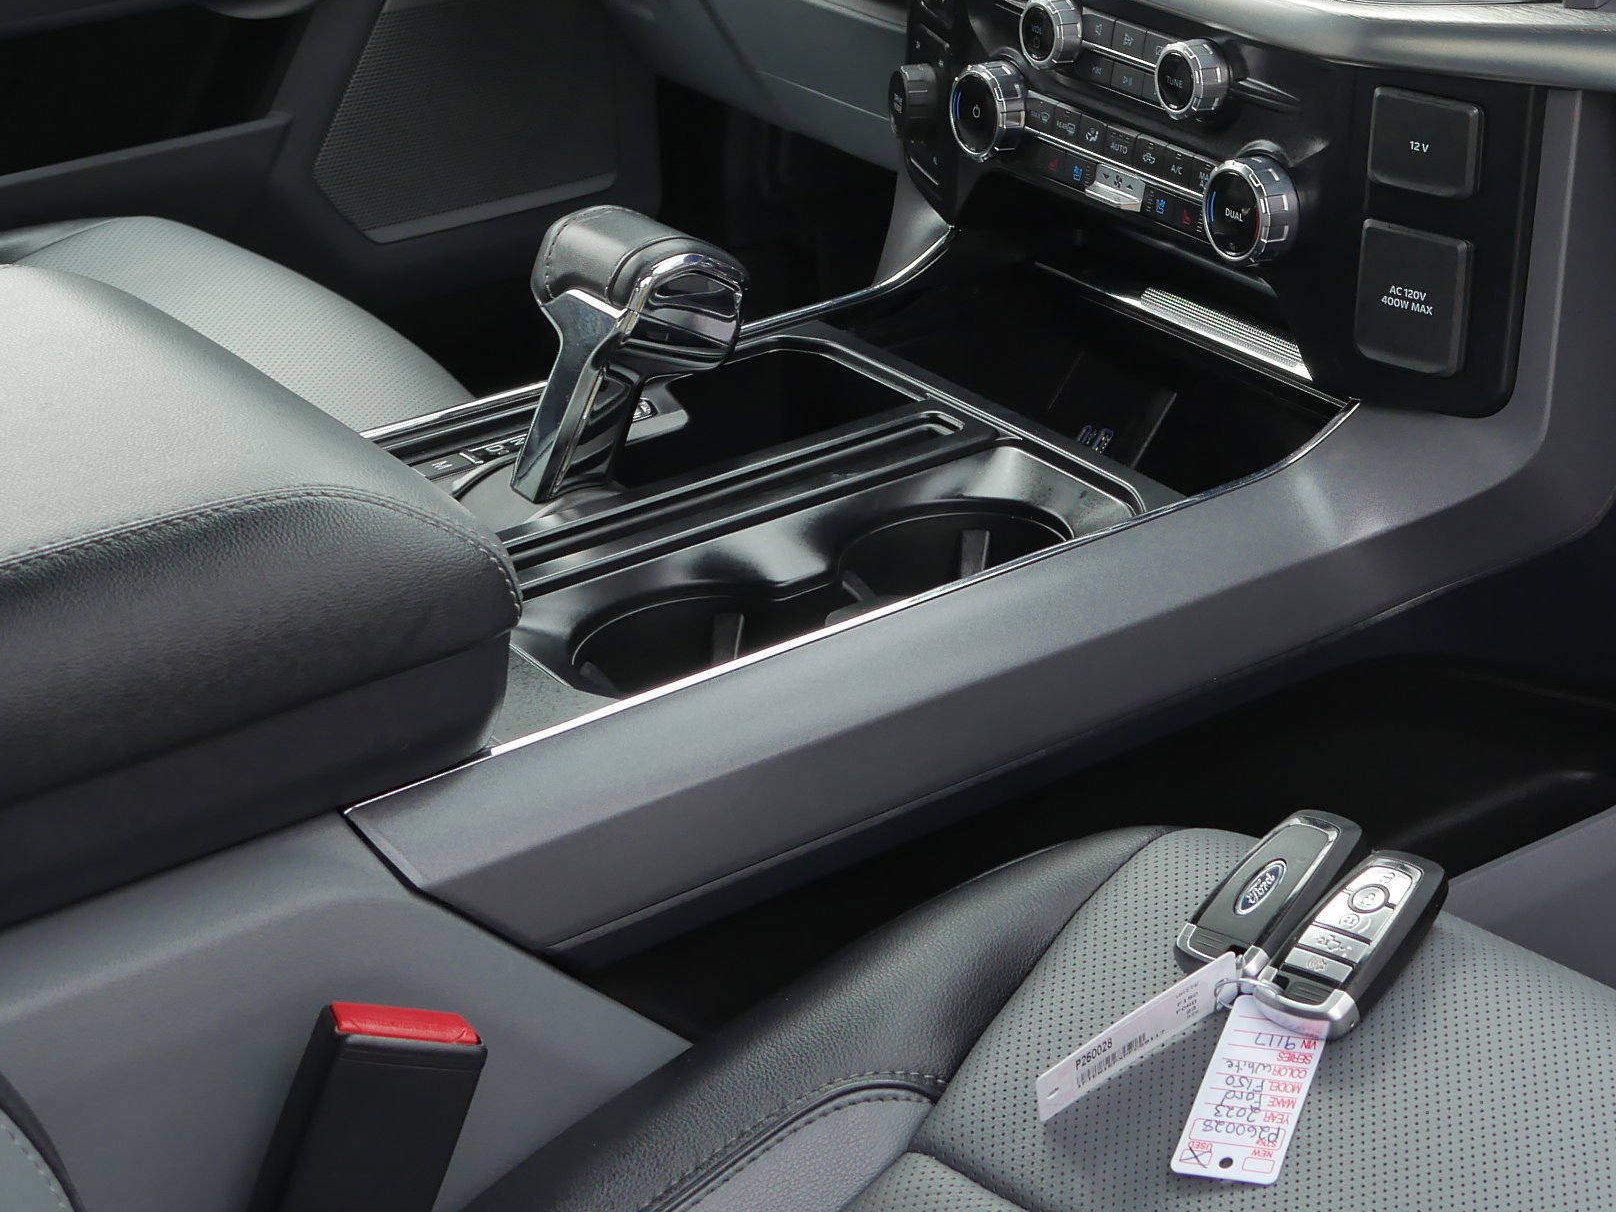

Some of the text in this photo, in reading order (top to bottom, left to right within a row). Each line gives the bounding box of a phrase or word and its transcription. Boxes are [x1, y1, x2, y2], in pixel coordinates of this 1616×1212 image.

[1166, 75, 1184, 89] TUNE
[1110, 142, 1128, 154] AUTO
[1410, 140, 1429, 153] 12 V
[1170, 162, 1183, 175] A/C
[1225, 207, 1243, 222] DUAL
[1389, 285, 1427, 301] AC 120V
[1381, 295, 1433, 316] 400W MAX
[1246, 873, 1276, 905] Ford
[1255, 1032, 1296, 1051] 9117
[1301, 1040, 1318, 1051] VIN
[1075, 1037, 1113, 1070] P260028
[1277, 1051, 1313, 1064] SERIES
[1272, 1068, 1308, 1079] COLOR
[1225, 1075, 1265, 1092] F150
[1269, 1082, 1303, 1094] MODEL
[1267, 1096, 1297, 1108] MAKE
[1214, 1105, 1261, 1122] 2023
[1263, 1113, 1290, 1124] YEAR
[1202, 1119, 1280, 1142] P260028
[1189, 1140, 1213, 1149] USED
[1251, 1149, 1273, 1158] NEW
